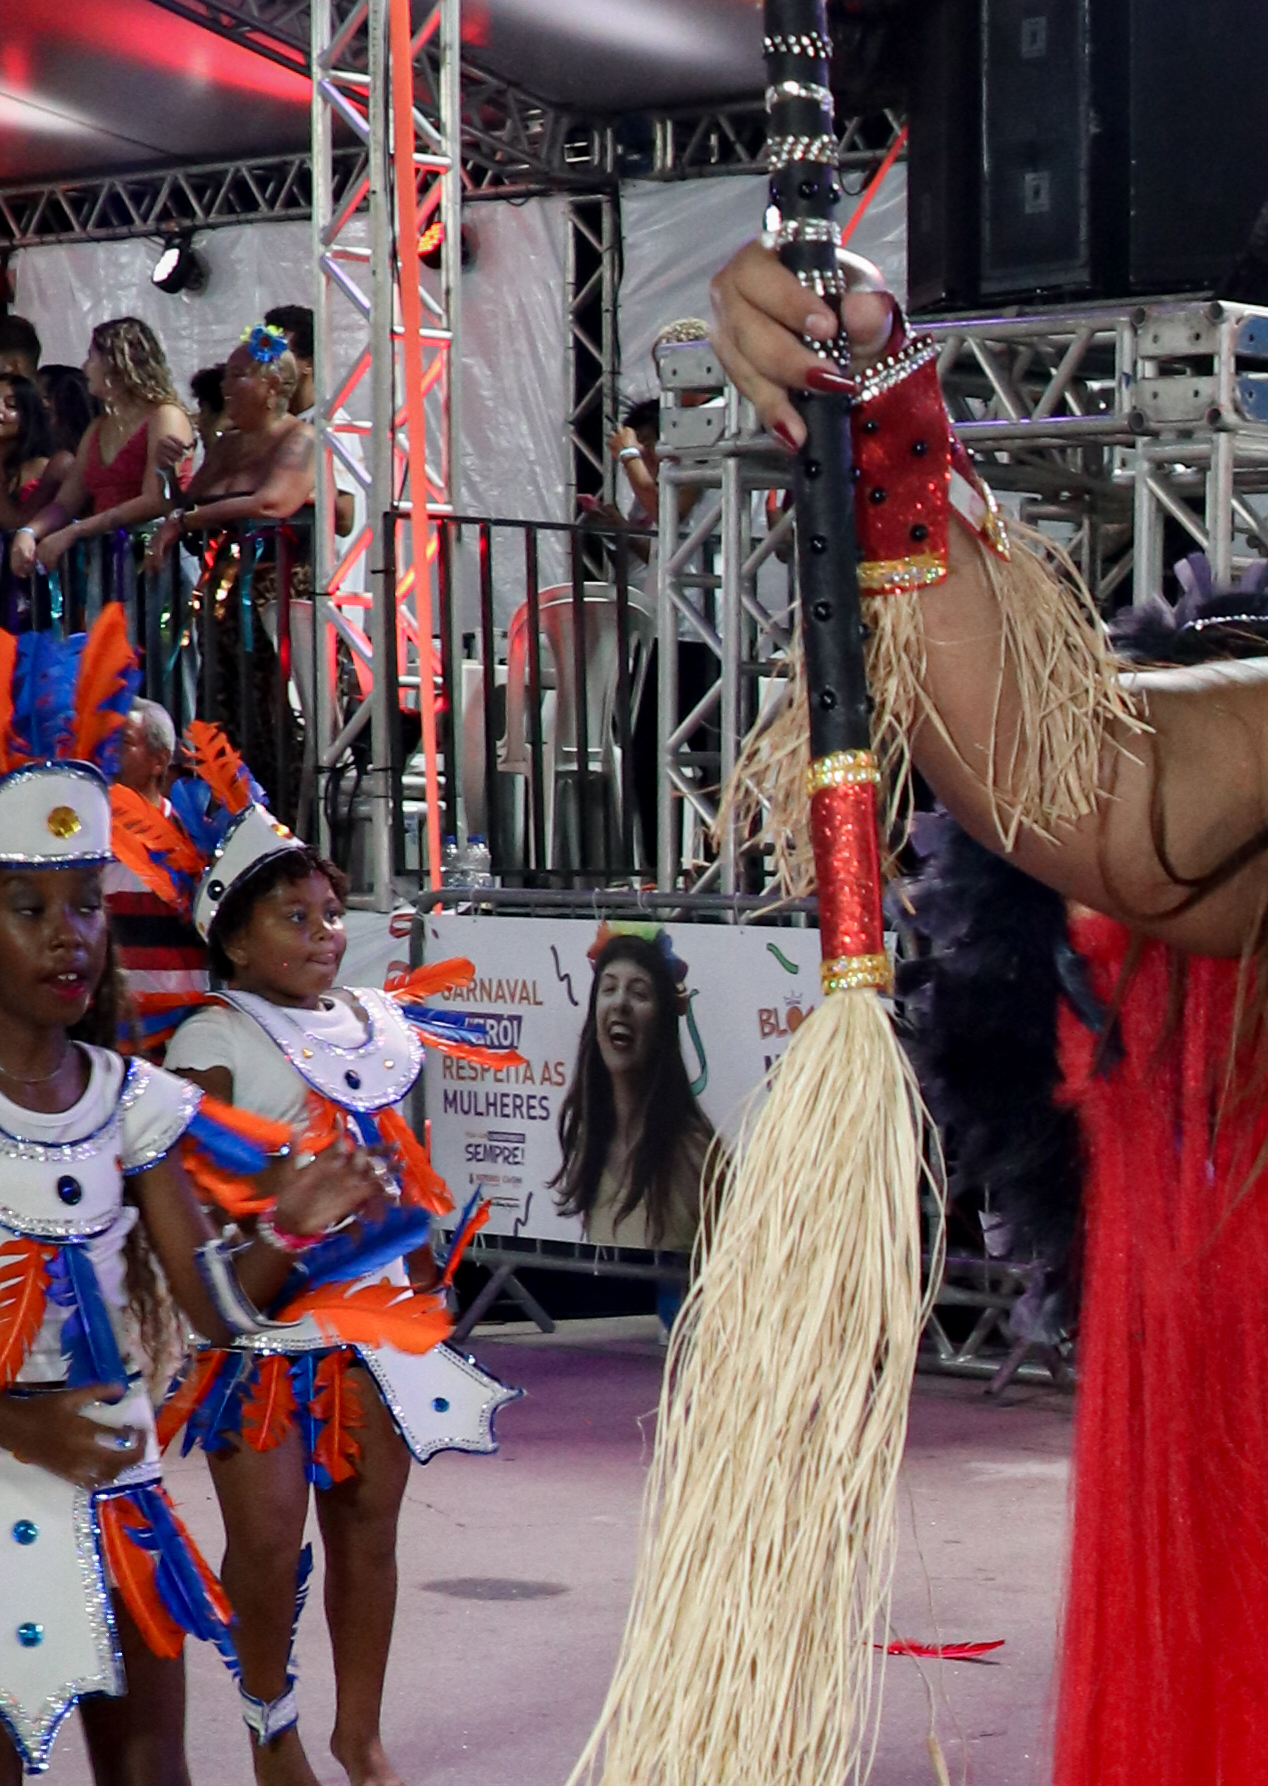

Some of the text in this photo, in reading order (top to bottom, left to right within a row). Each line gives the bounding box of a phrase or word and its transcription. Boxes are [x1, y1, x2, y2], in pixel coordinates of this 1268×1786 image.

[540, 1060, 567, 1087] AS
[442, 1088, 551, 1121] MULHERES
[465, 1143, 525, 1165] SEMPRE!
